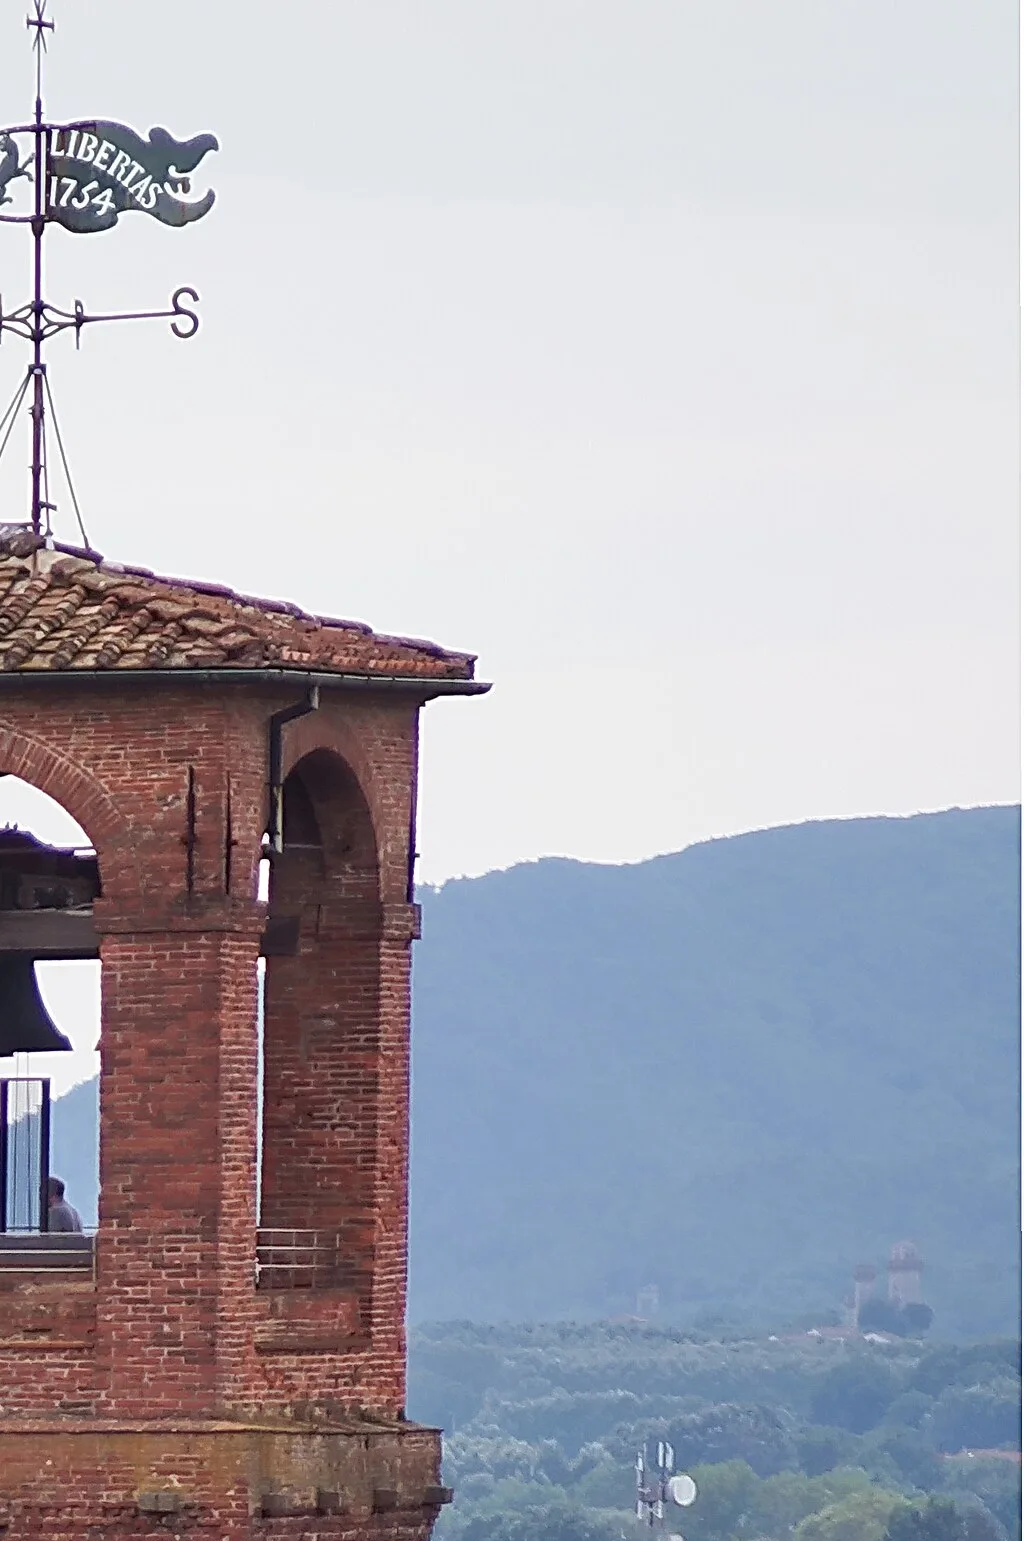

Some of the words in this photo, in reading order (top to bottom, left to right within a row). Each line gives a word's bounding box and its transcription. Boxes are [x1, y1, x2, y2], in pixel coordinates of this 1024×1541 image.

[50, 128, 164, 209] LIBERTAS
[49, 176, 116, 216] 1754
[171, 287, 200, 338] S
